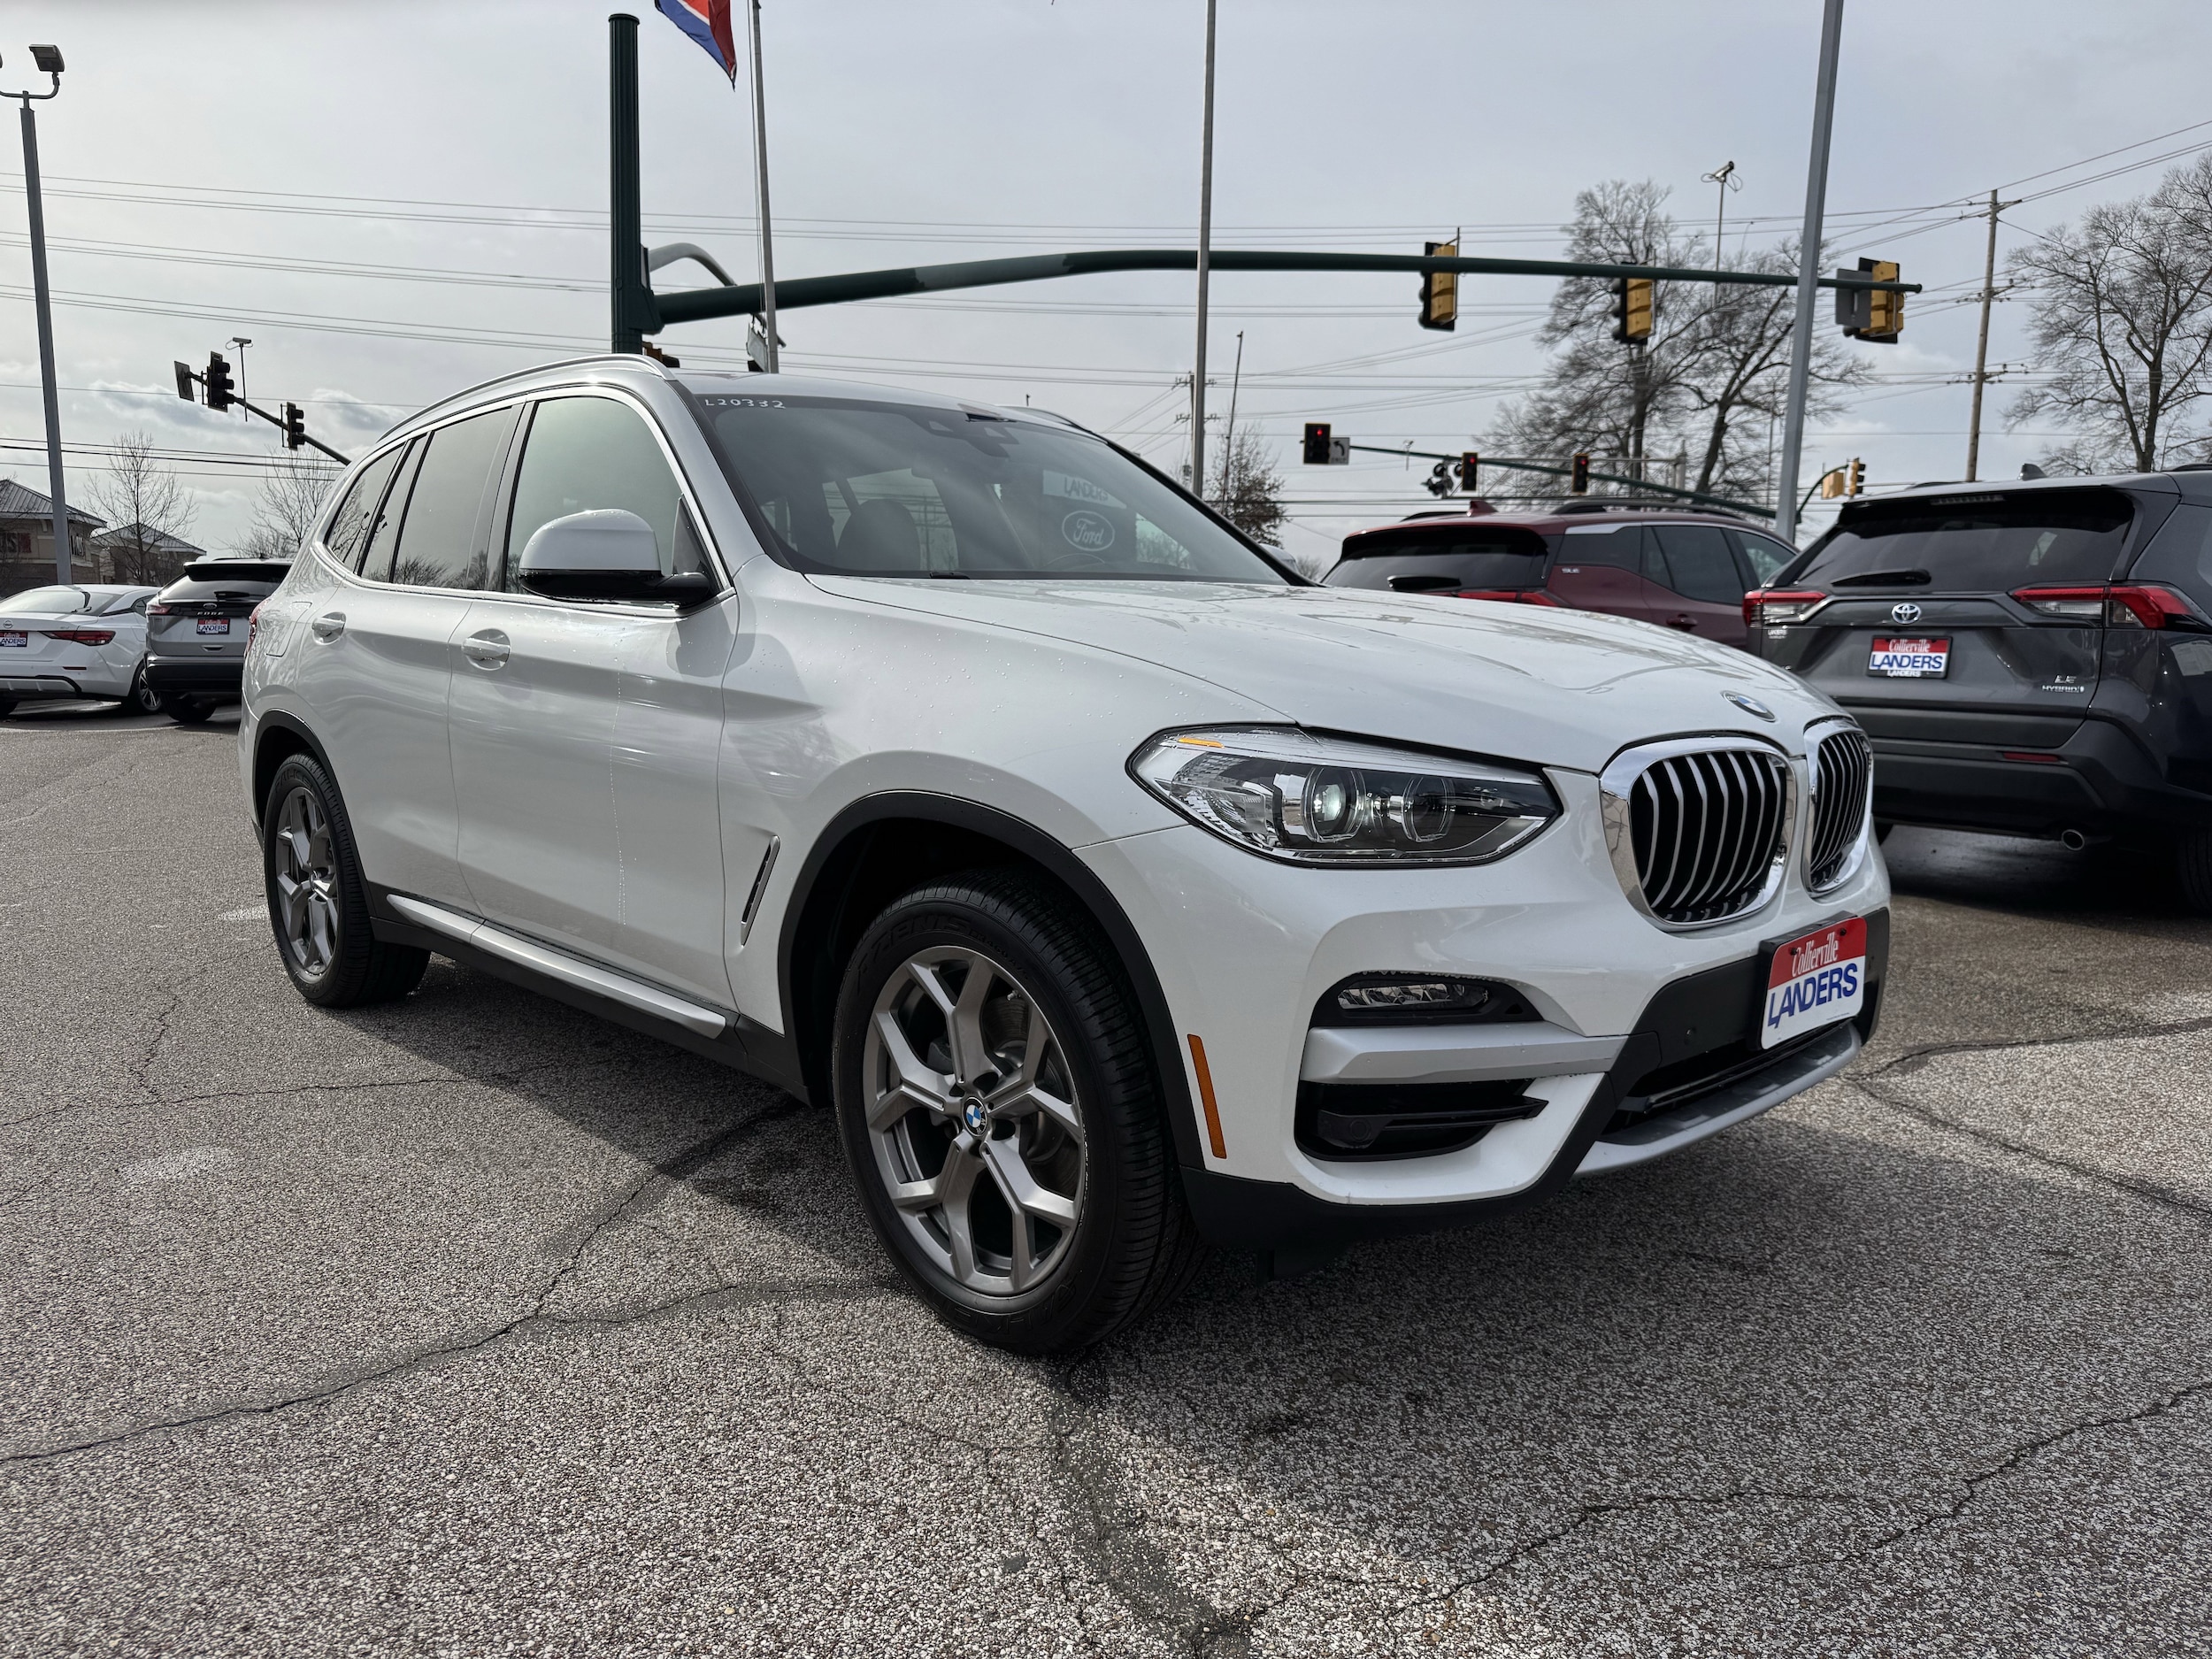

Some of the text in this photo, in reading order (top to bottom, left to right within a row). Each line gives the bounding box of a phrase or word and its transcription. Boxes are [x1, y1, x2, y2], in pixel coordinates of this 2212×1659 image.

[704, 398, 786, 409] L20332
[1064, 476, 1109, 502] LANDERS
[1073, 518, 1104, 546] Ford
[1889, 639, 1930, 652] Collierville
[1871, 655, 1943, 670] LANDERS
[1792, 932, 1839, 978] Collierville
[1768, 963, 1858, 1029] LANDERS
